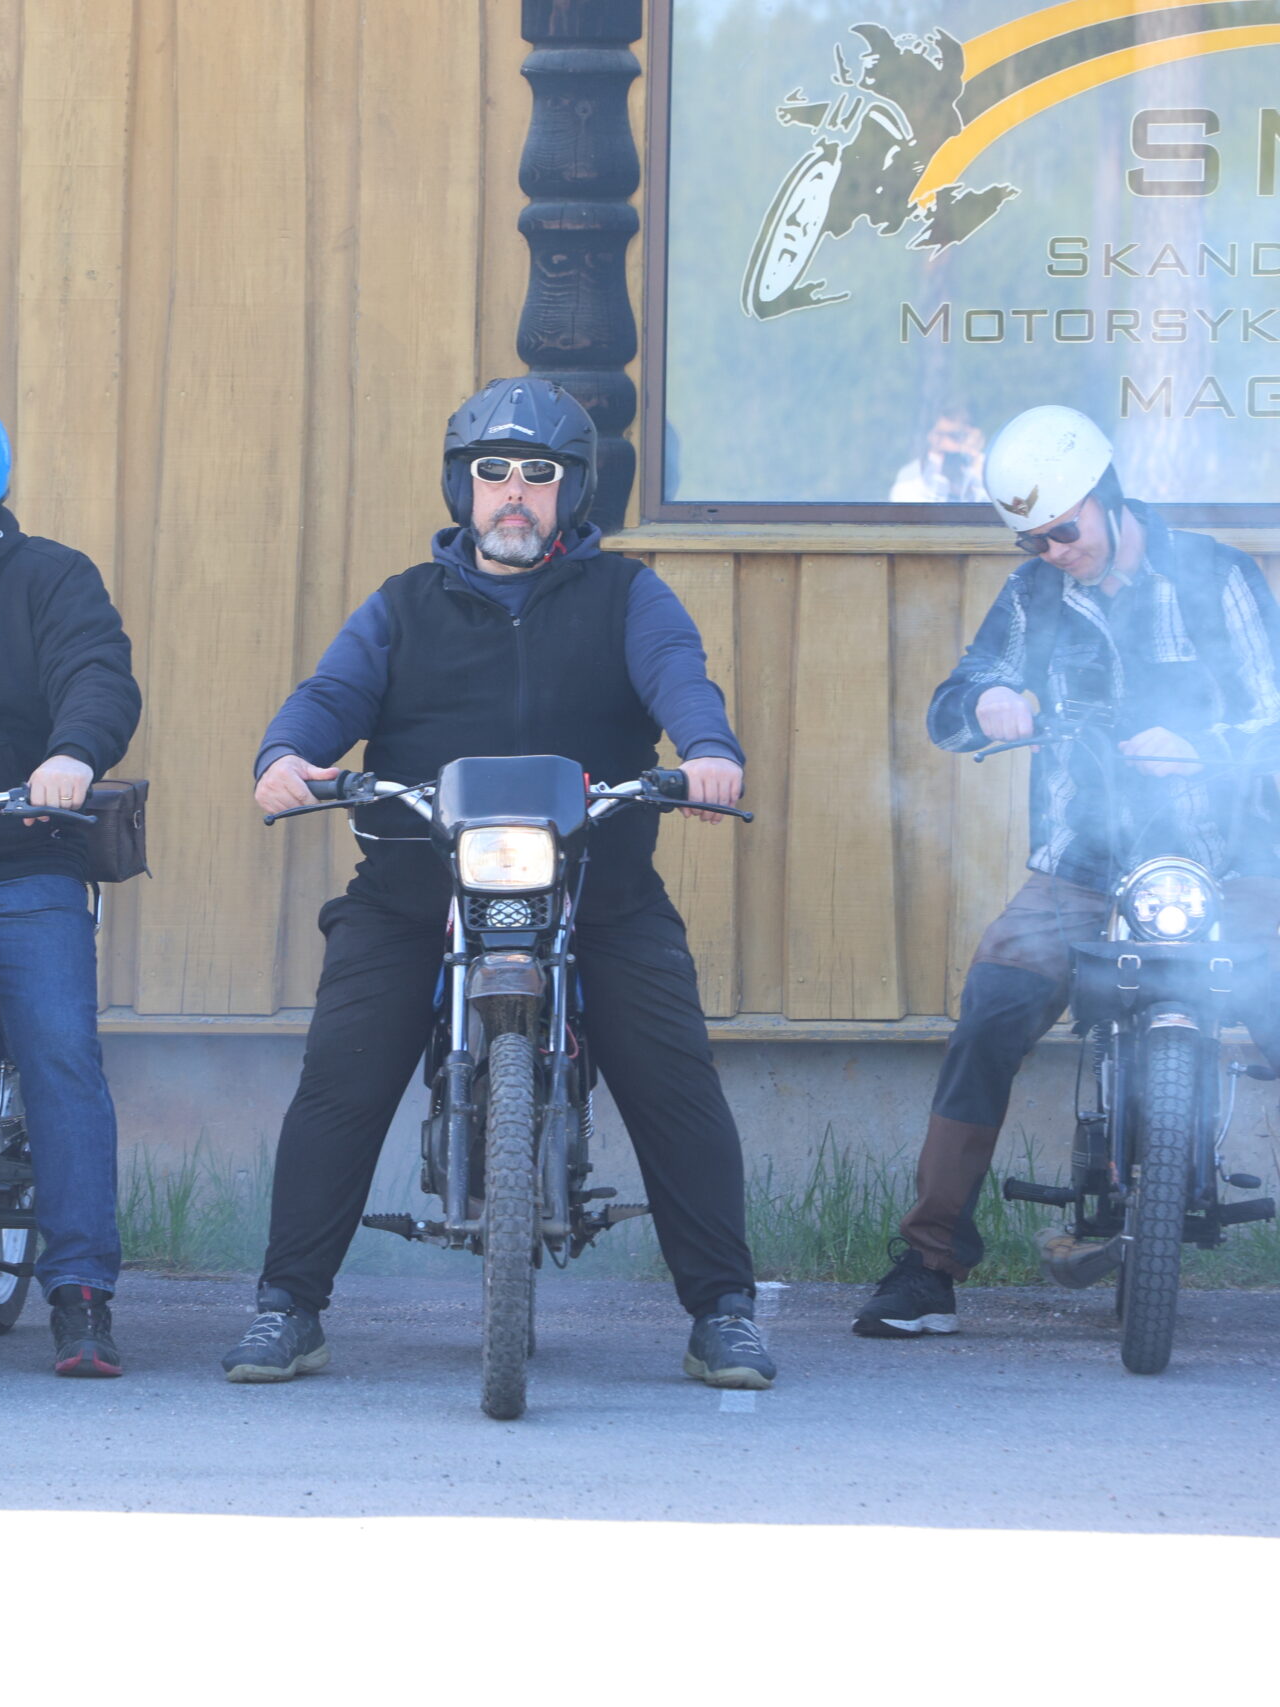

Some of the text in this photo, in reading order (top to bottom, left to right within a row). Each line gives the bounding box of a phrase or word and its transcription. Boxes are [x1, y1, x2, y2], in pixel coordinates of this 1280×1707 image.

[1126, 107, 1280, 197] S
[1046, 236, 1280, 278] SKAND
[899, 301, 1280, 343] MOTORSYK
[1120, 375, 1280, 419] MAG
